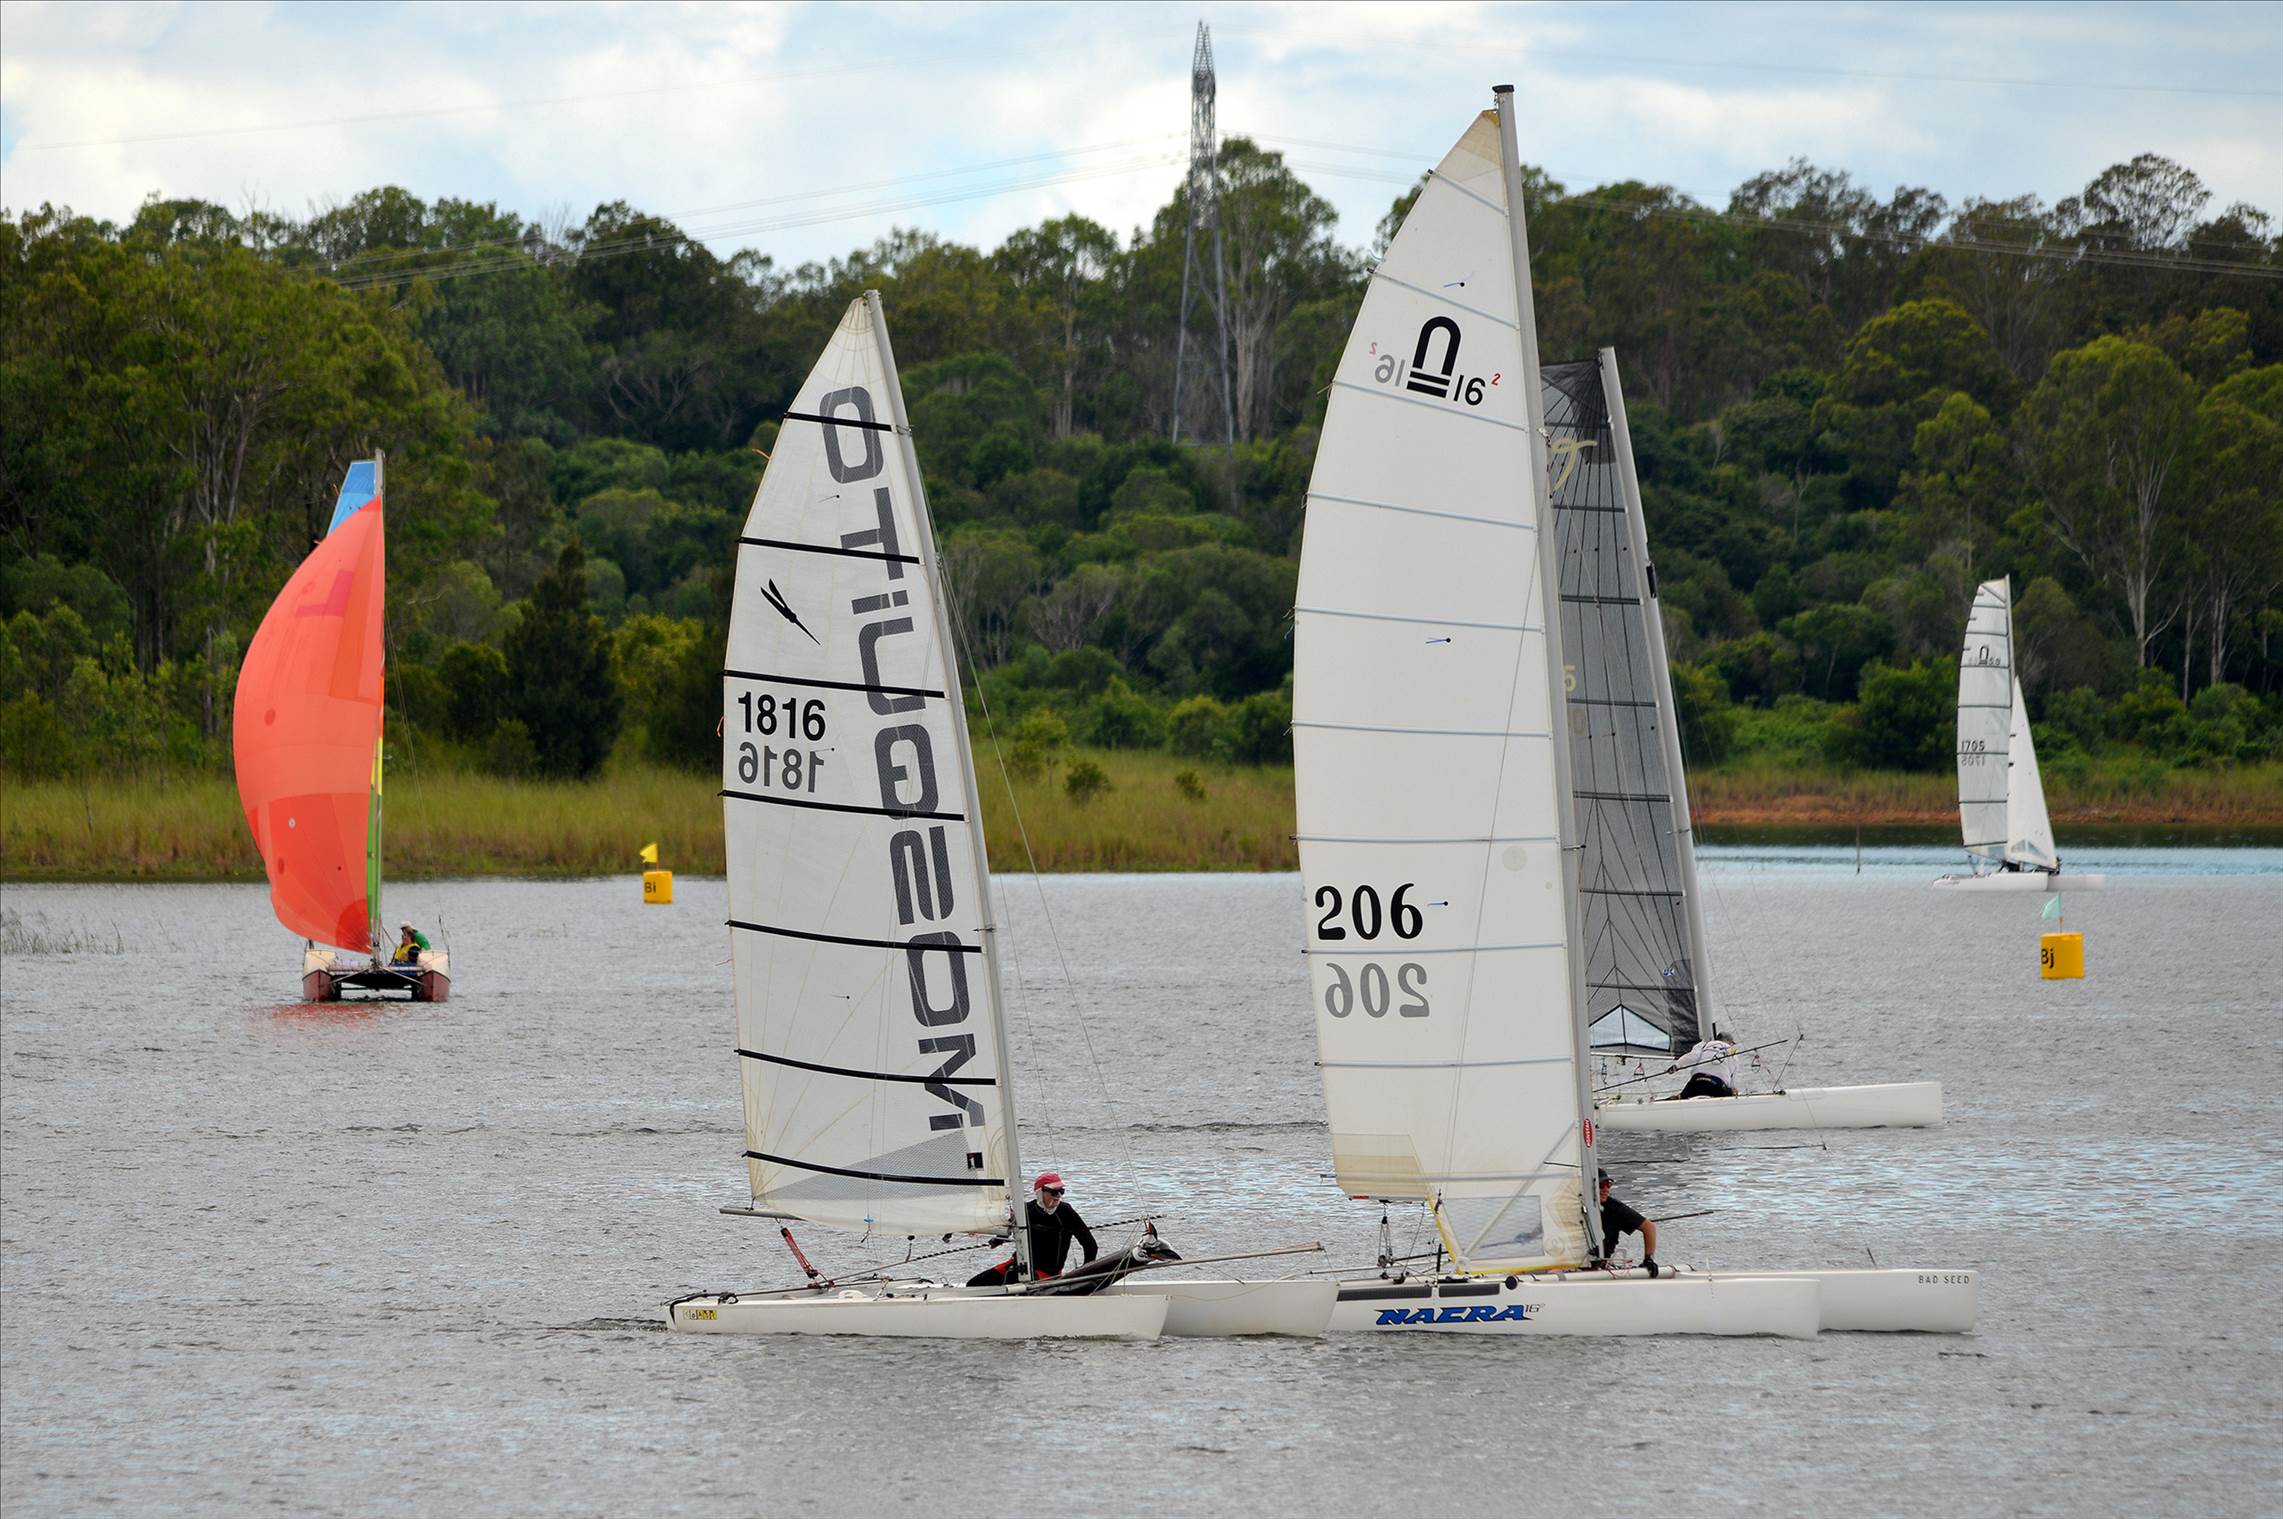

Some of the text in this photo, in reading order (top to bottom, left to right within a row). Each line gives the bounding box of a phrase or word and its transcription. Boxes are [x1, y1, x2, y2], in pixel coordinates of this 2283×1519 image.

[737, 691, 827, 742] 1816
[1961, 740, 1985, 753] 1705
[1315, 883, 1423, 940] 206
[1918, 1275, 1970, 1284] BAD SEED
[1373, 1303, 1534, 1325] NACRA
